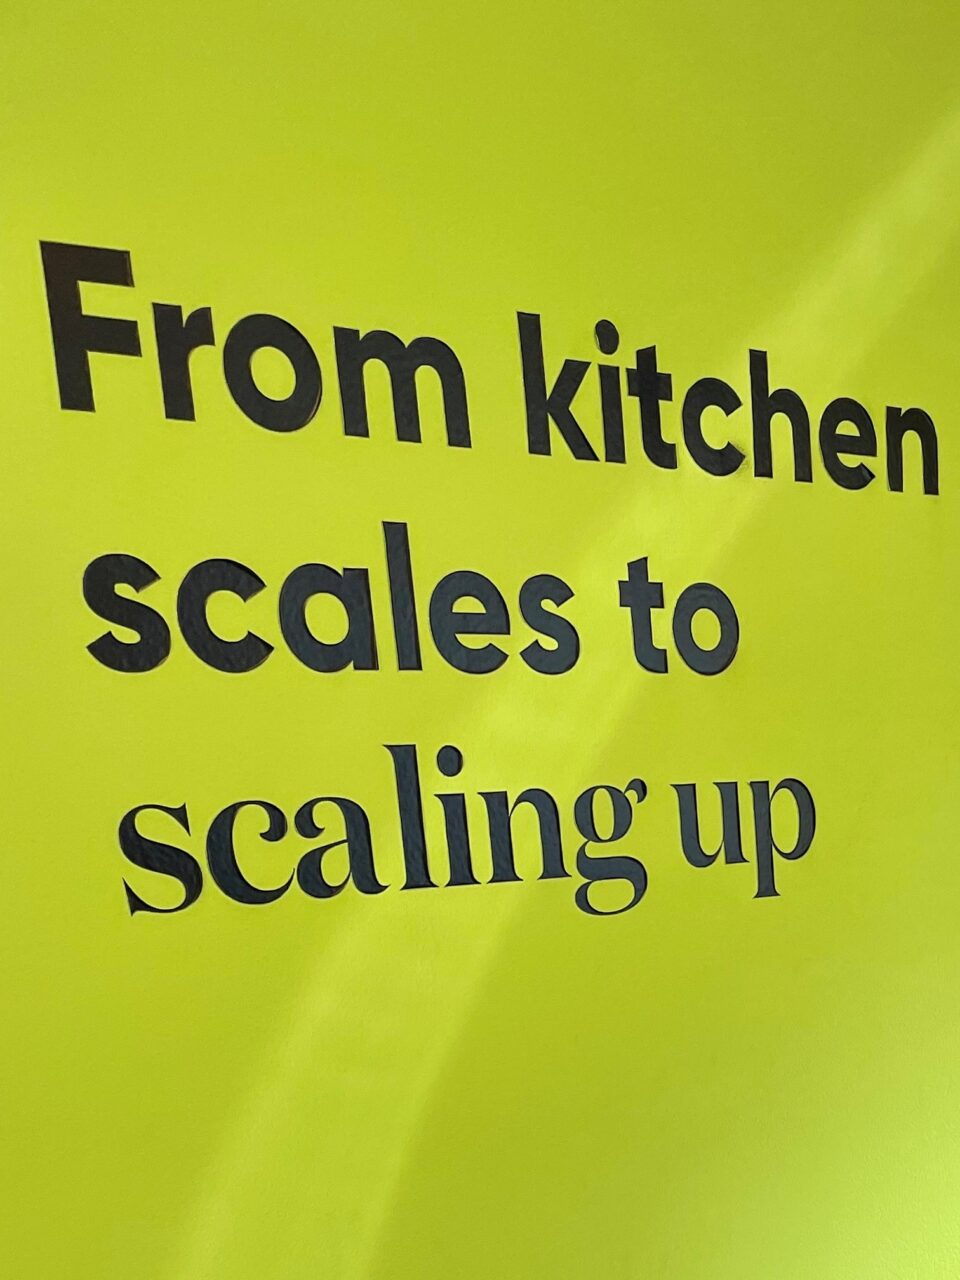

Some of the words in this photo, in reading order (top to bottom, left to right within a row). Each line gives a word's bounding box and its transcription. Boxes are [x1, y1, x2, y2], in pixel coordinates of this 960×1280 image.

[38, 239, 473, 449] From
[515, 310, 940, 496] kitchen
[82, 520, 581, 675] scales
[617, 556, 741, 676] to
[117, 744, 648, 916] scaling
[670, 775, 817, 899] up
